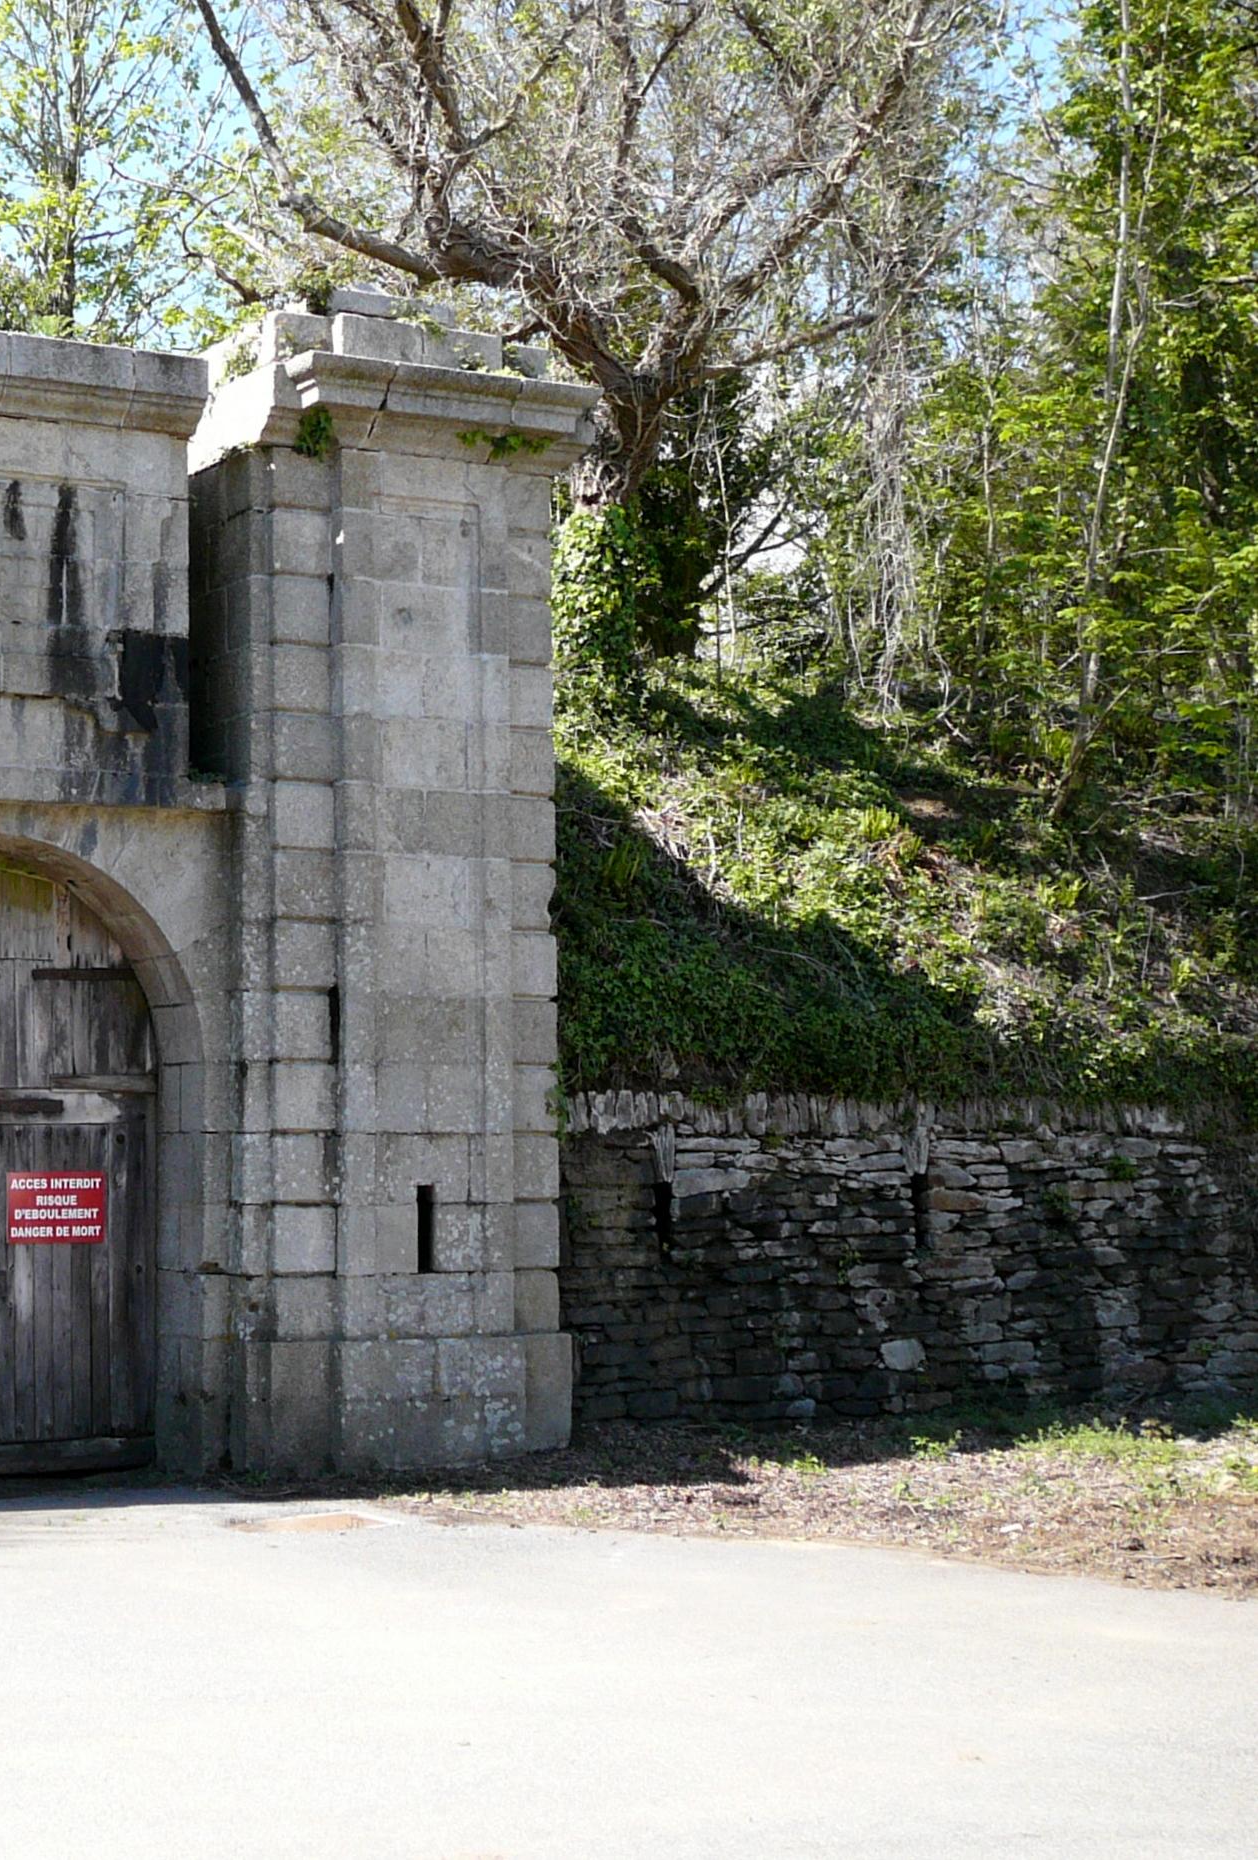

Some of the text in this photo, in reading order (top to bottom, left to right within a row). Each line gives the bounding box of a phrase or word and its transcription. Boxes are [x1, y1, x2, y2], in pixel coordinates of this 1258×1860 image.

[11, 1178, 102, 1190] ACCES INTERDIT
[36, 1195, 78, 1206] RISQUE
[14, 1208, 99, 1220] D'EBOULEMENT
[10, 1225, 102, 1238] DANGER DE MORT
